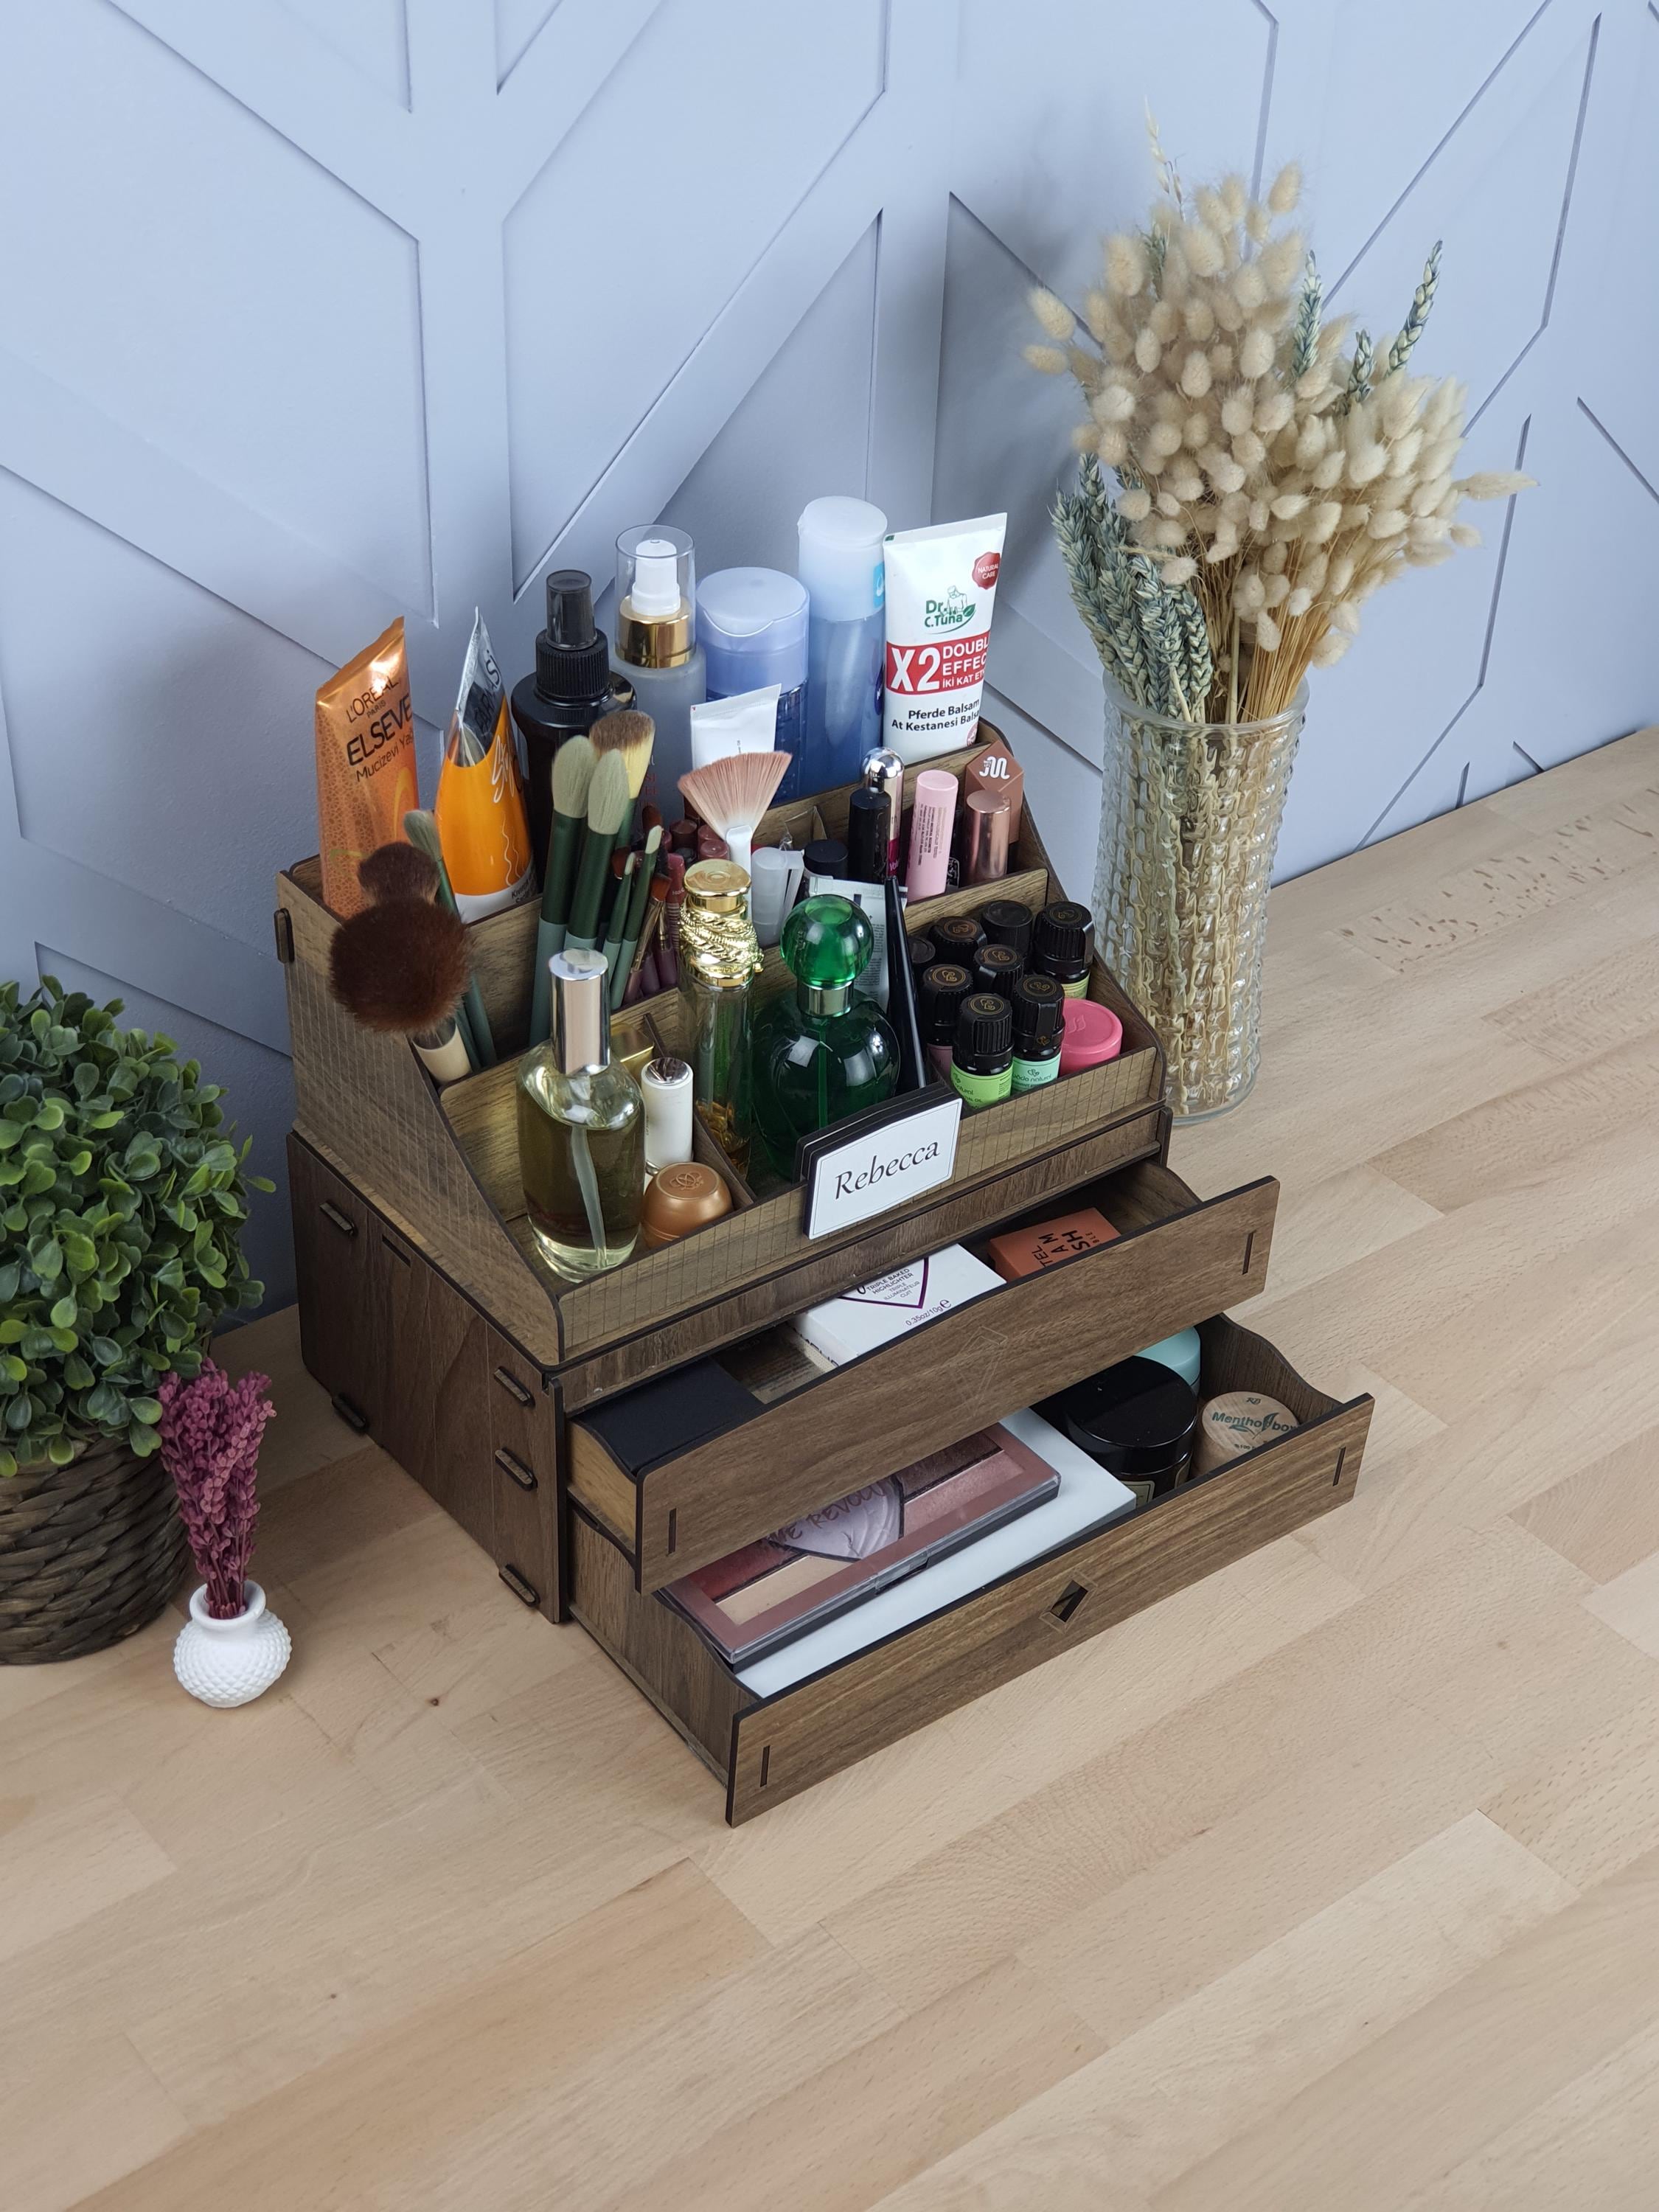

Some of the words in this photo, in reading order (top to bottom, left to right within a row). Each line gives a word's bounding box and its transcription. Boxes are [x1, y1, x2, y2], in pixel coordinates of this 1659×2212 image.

[982, 571, 996, 580] CARE
[926, 599, 947, 614] Dr.
[925, 613, 963, 627] C.Tuna
[942, 636, 990, 659] DOUBL
[891, 647, 941, 692] X2
[942, 653, 987, 675] EFFEC
[956, 674, 973, 685] KAT
[366, 700, 386, 718] PARIS
[908, 708, 945, 720] Pferde
[947, 699, 980, 716] Balsam
[347, 693, 413, 766] ELSEVE
[891, 720, 903, 730] At
[905, 717, 958, 731] Kestanesi
[356, 746, 400, 782] Mucizevi
[835, 1141, 940, 1200] Rebecca
[866, 1279, 888, 1291] TRIPLE
[888, 1268, 910, 1281] BAKED
[872, 1273, 914, 1294] HIGHLIGHTER
[889, 1282, 906, 1292] TRIPLE
[884, 1281, 920, 1300] ILLUMINATEUR
